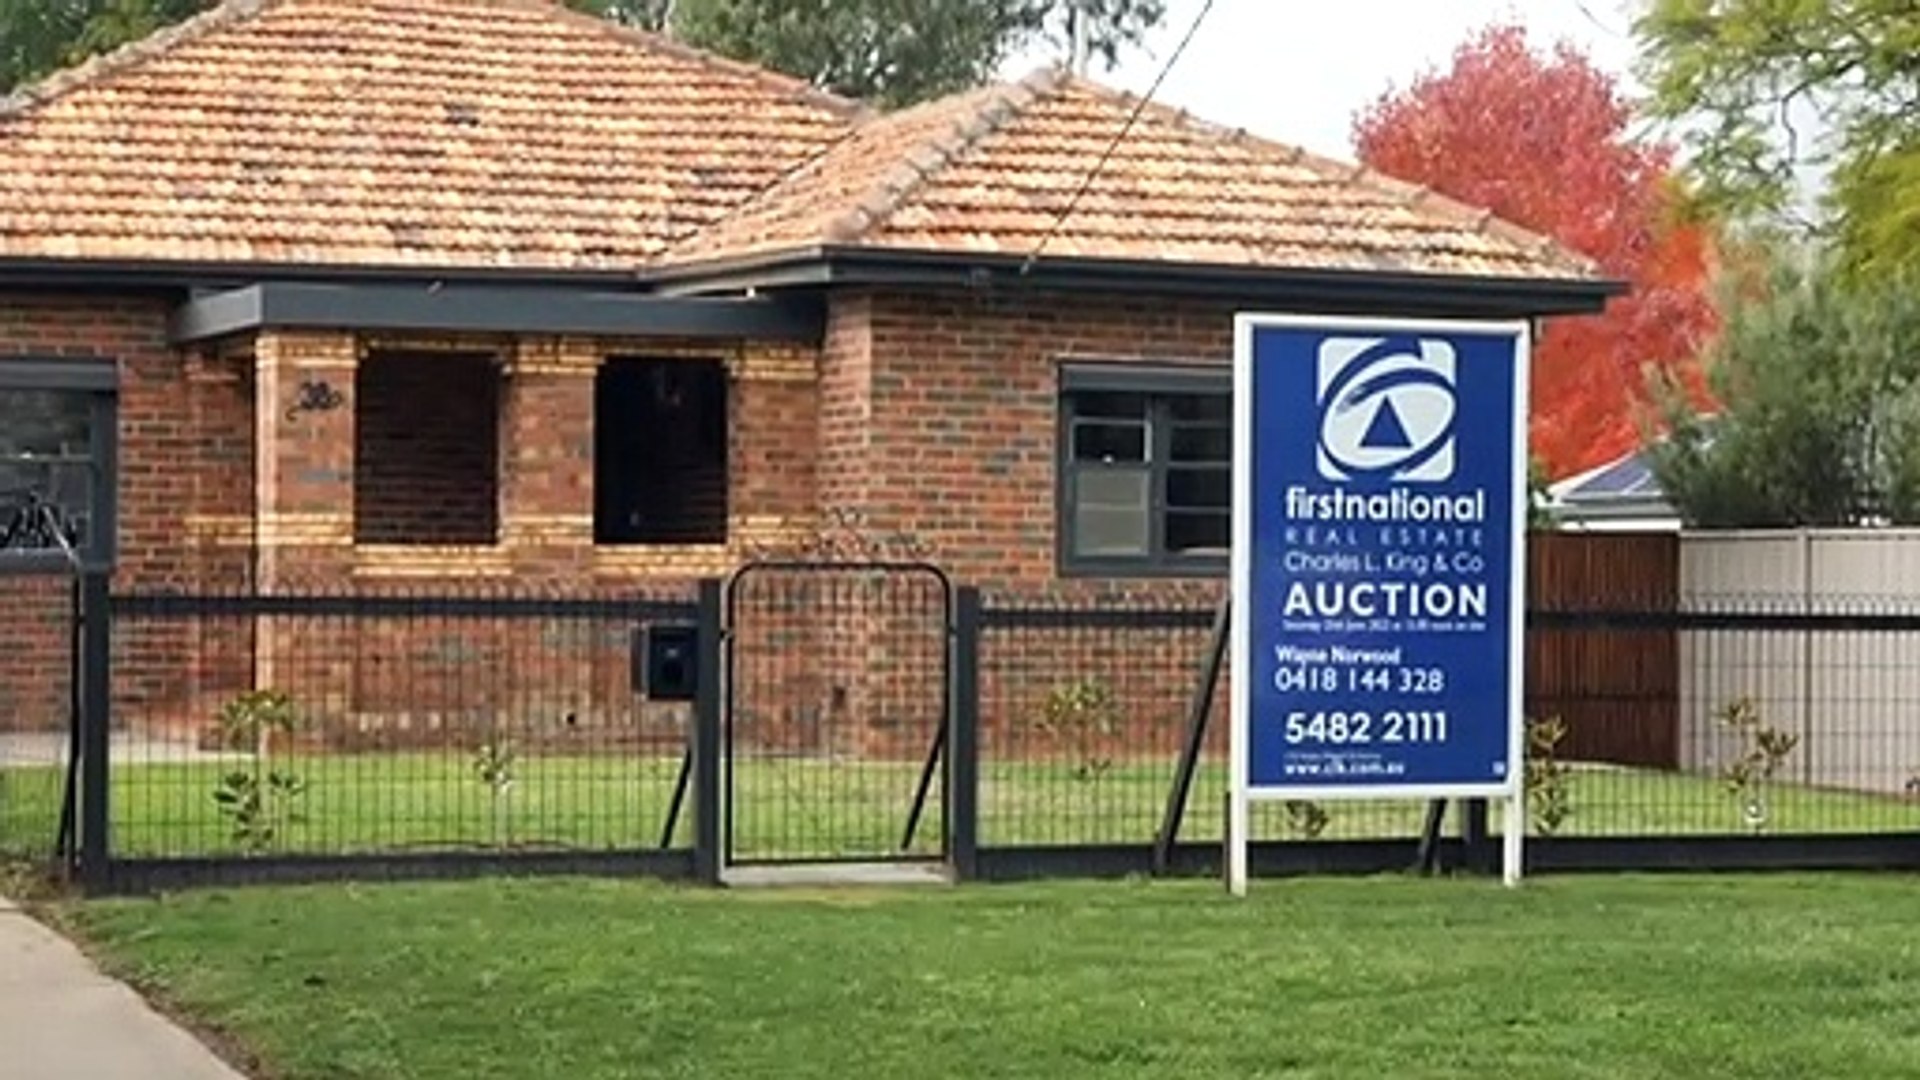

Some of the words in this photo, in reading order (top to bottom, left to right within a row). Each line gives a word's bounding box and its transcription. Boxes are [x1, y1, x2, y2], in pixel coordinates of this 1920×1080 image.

[1286, 486, 1484, 521] firstnational
[1285, 527, 1357, 546] REAL
[1380, 528, 1482, 546] ESTATE
[1284, 550, 1361, 573] Charles
[1364, 553, 1381, 573] L.
[1386, 551, 1429, 578] King
[1433, 553, 1449, 573] &
[1453, 552, 1484, 573] Co
[1283, 582, 1487, 617] AUCTION
[1275, 645, 1328, 667] Wayne
[1331, 645, 1401, 665] Norwood
[1274, 667, 1338, 692] 0418
[1349, 667, 1390, 691] 144
[1398, 667, 1445, 693] 328
[1285, 711, 1371, 743] 5482
[1382, 711, 1447, 743] 2111
